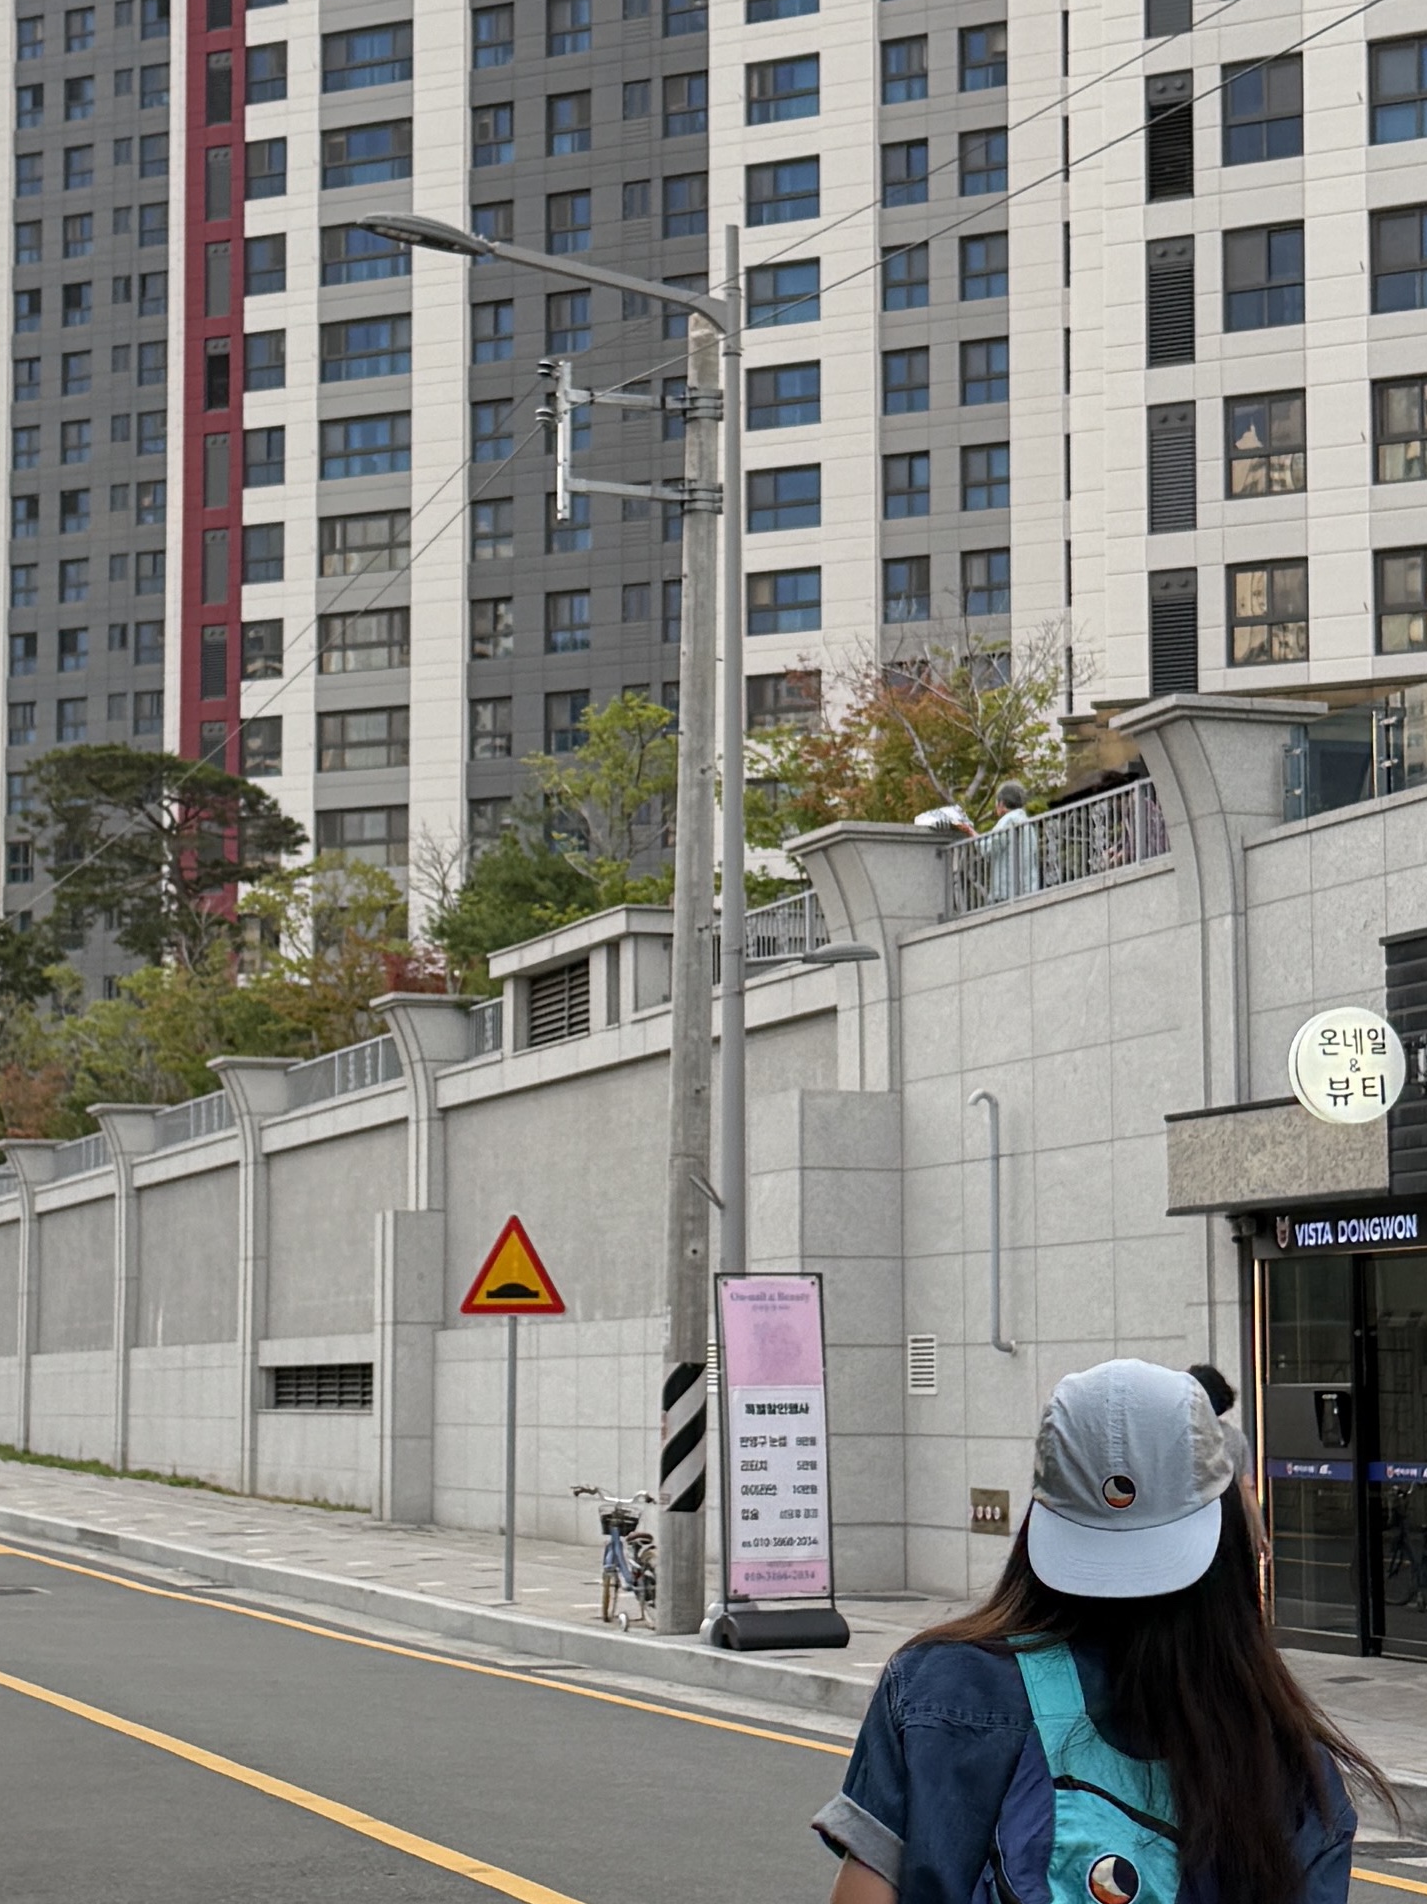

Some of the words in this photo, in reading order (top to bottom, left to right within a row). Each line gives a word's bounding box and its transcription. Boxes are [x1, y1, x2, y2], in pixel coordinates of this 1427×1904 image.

[1319, 1027, 1387, 1056] 온네일
[1349, 1059, 1361, 1072] &
[1295, 1220, 1333, 1247] VISTA
[1337, 1213, 1418, 1245] DONGWON
